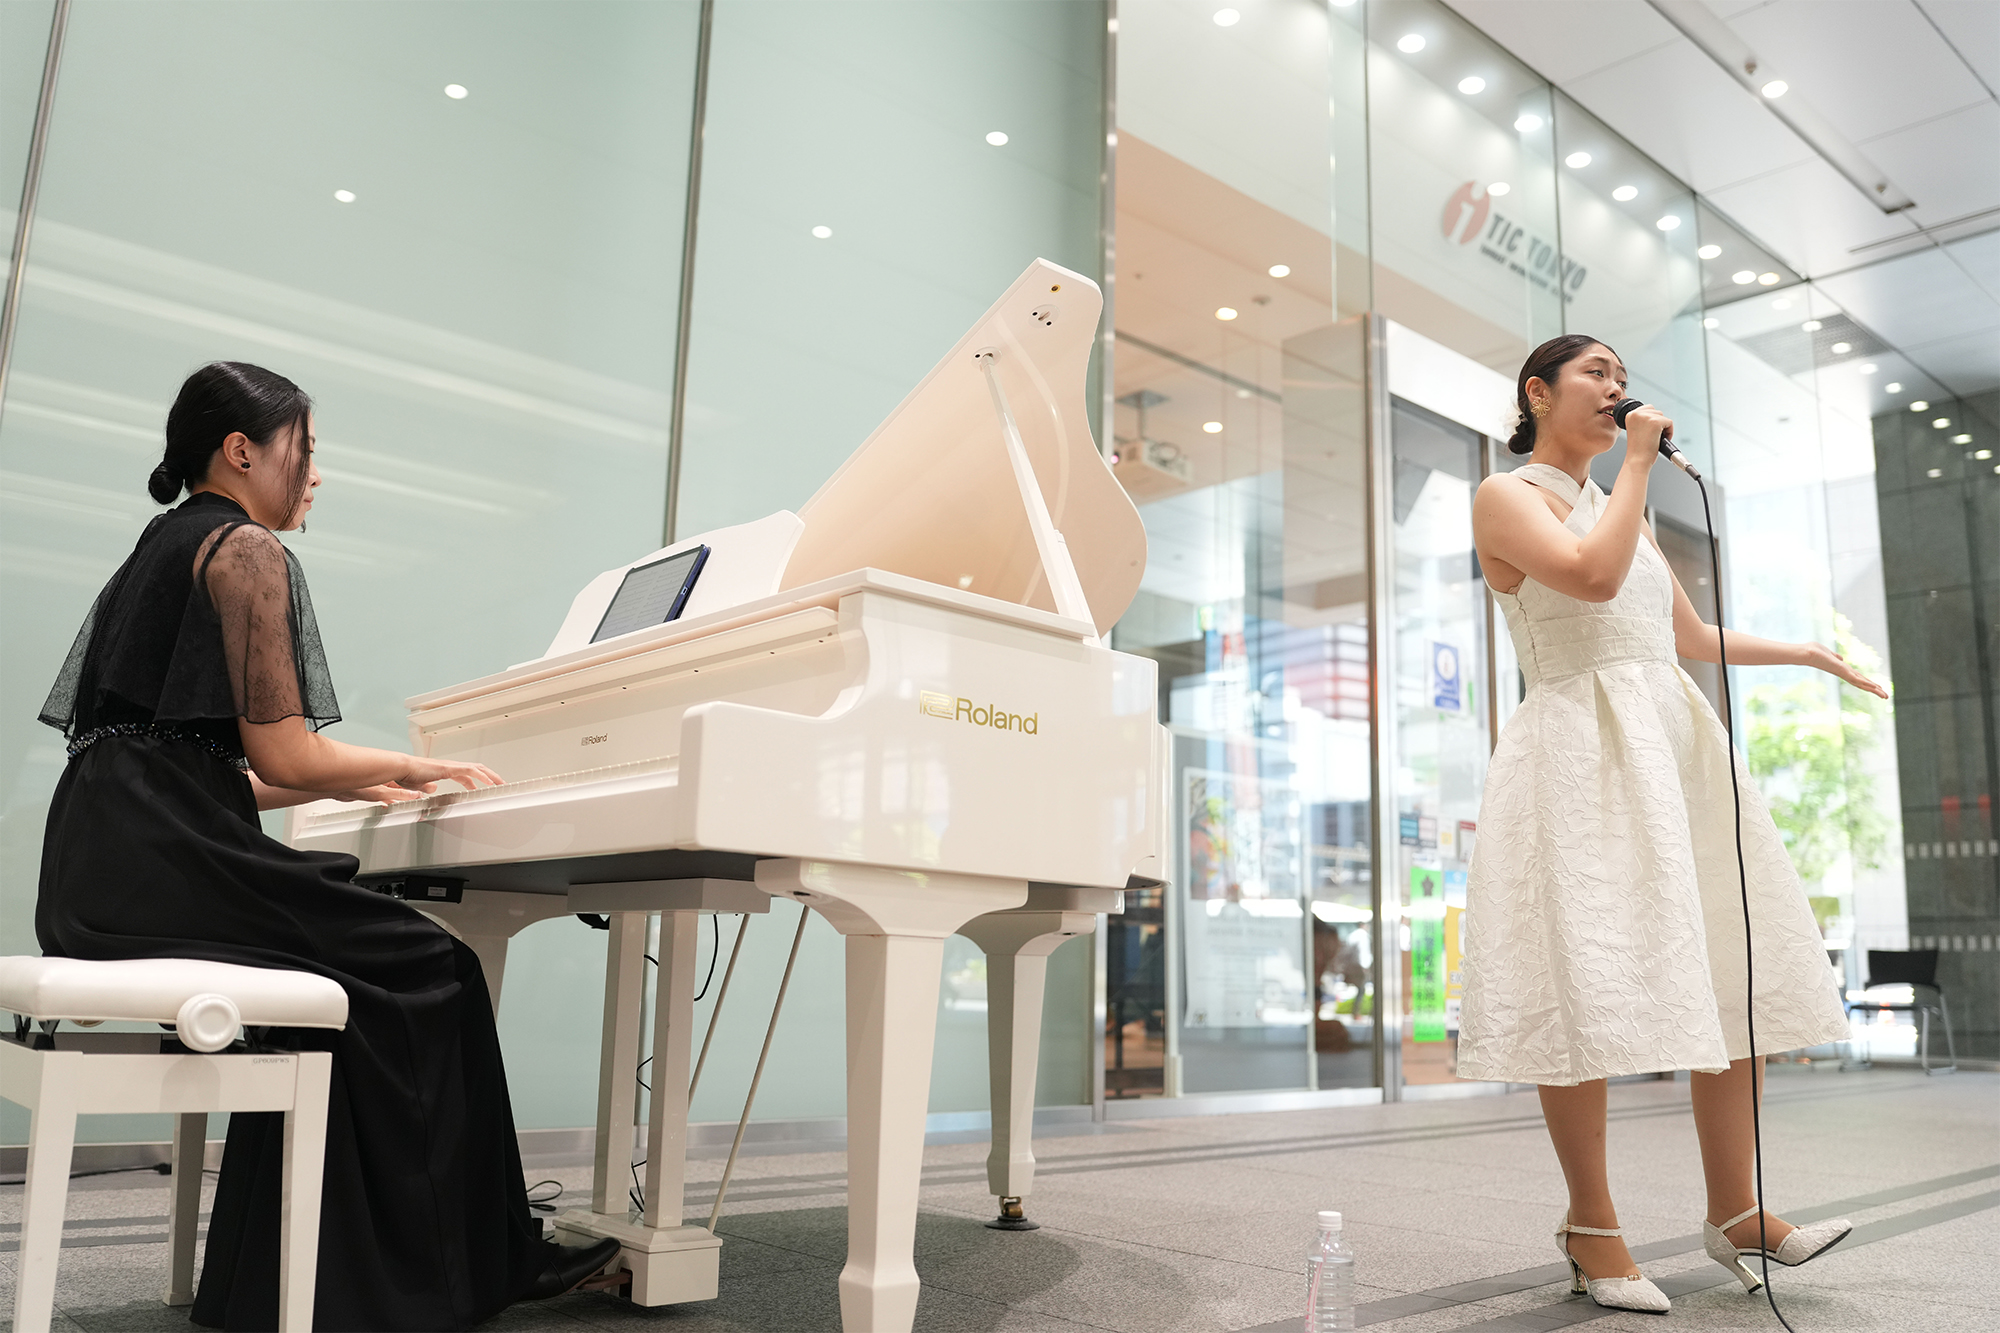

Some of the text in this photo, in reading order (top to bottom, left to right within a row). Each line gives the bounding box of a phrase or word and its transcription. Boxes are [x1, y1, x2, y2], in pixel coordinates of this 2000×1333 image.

[1487, 213, 1524, 252] TIC
[955, 697, 1038, 735] Roland
[589, 733, 608, 744] Roland
